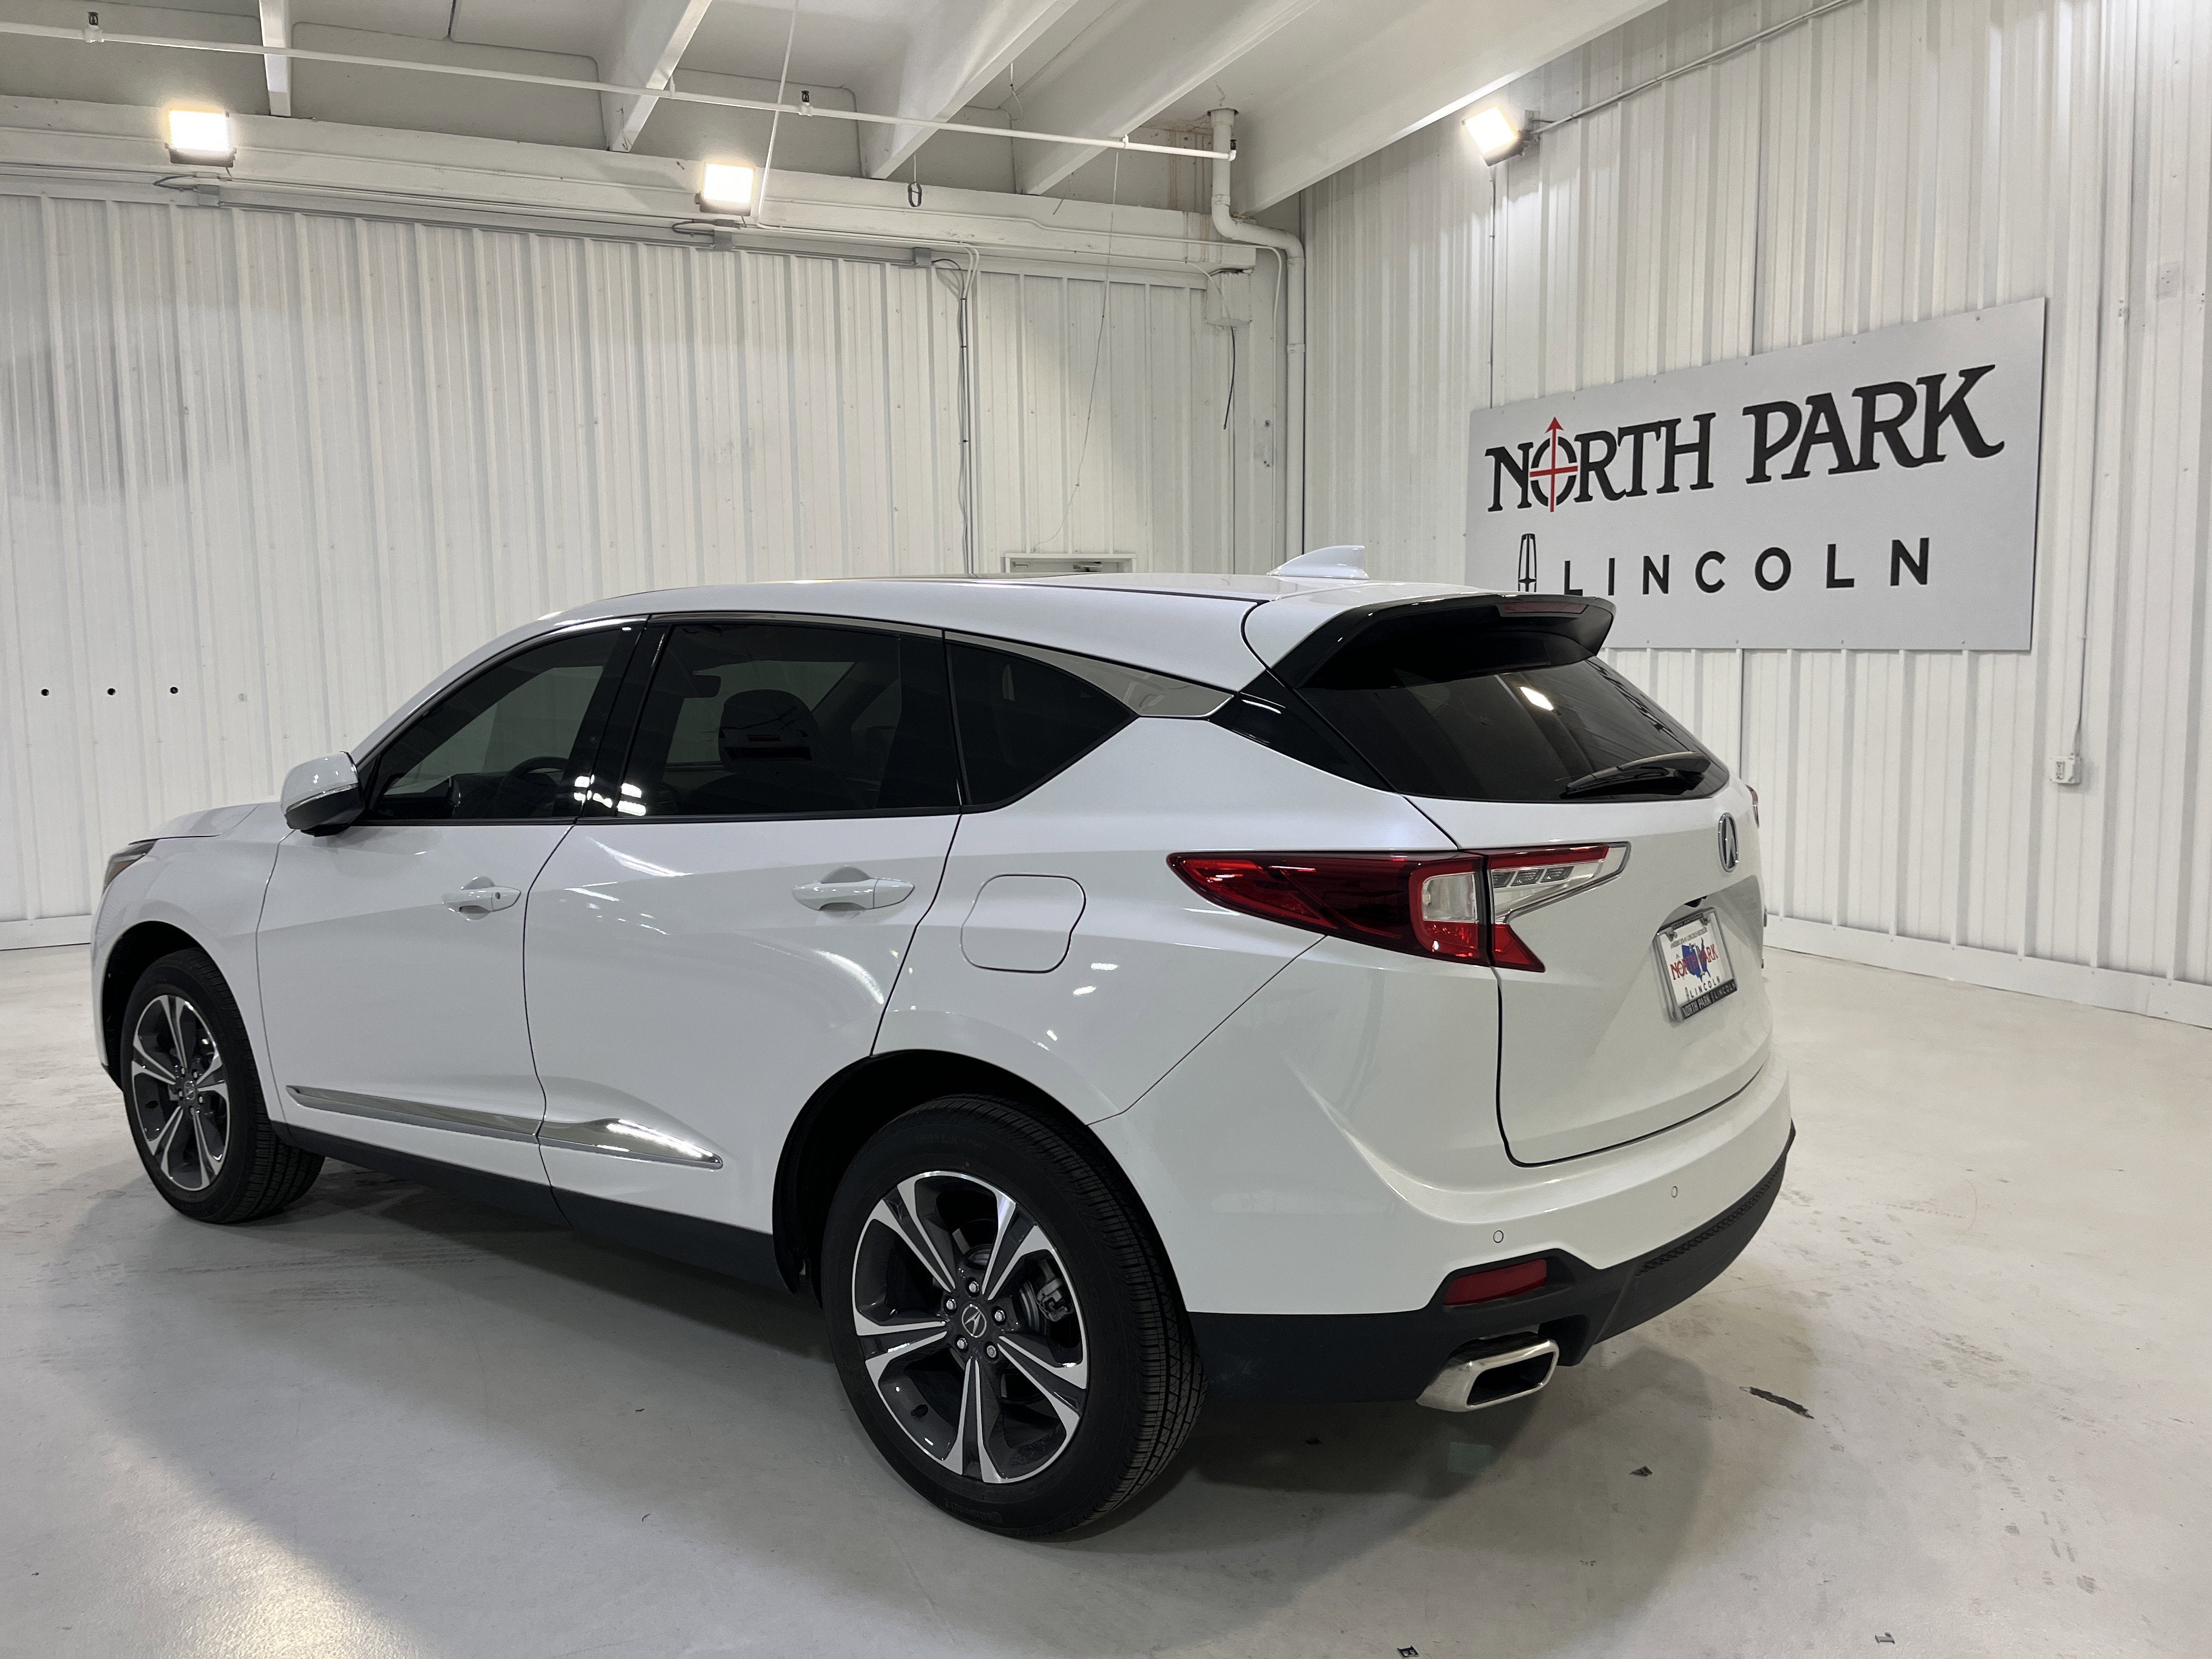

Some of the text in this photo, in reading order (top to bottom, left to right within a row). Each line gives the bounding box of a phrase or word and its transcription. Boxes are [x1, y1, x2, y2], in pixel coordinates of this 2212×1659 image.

[1485, 364, 2005, 512] NORTH PARK
[1564, 537, 1929, 597] LINCOLN
[1690, 976, 1720, 998] LINCOLN
[1697, 994, 1711, 1009] PARK
[1714, 982, 1736, 998] LINCOLN
